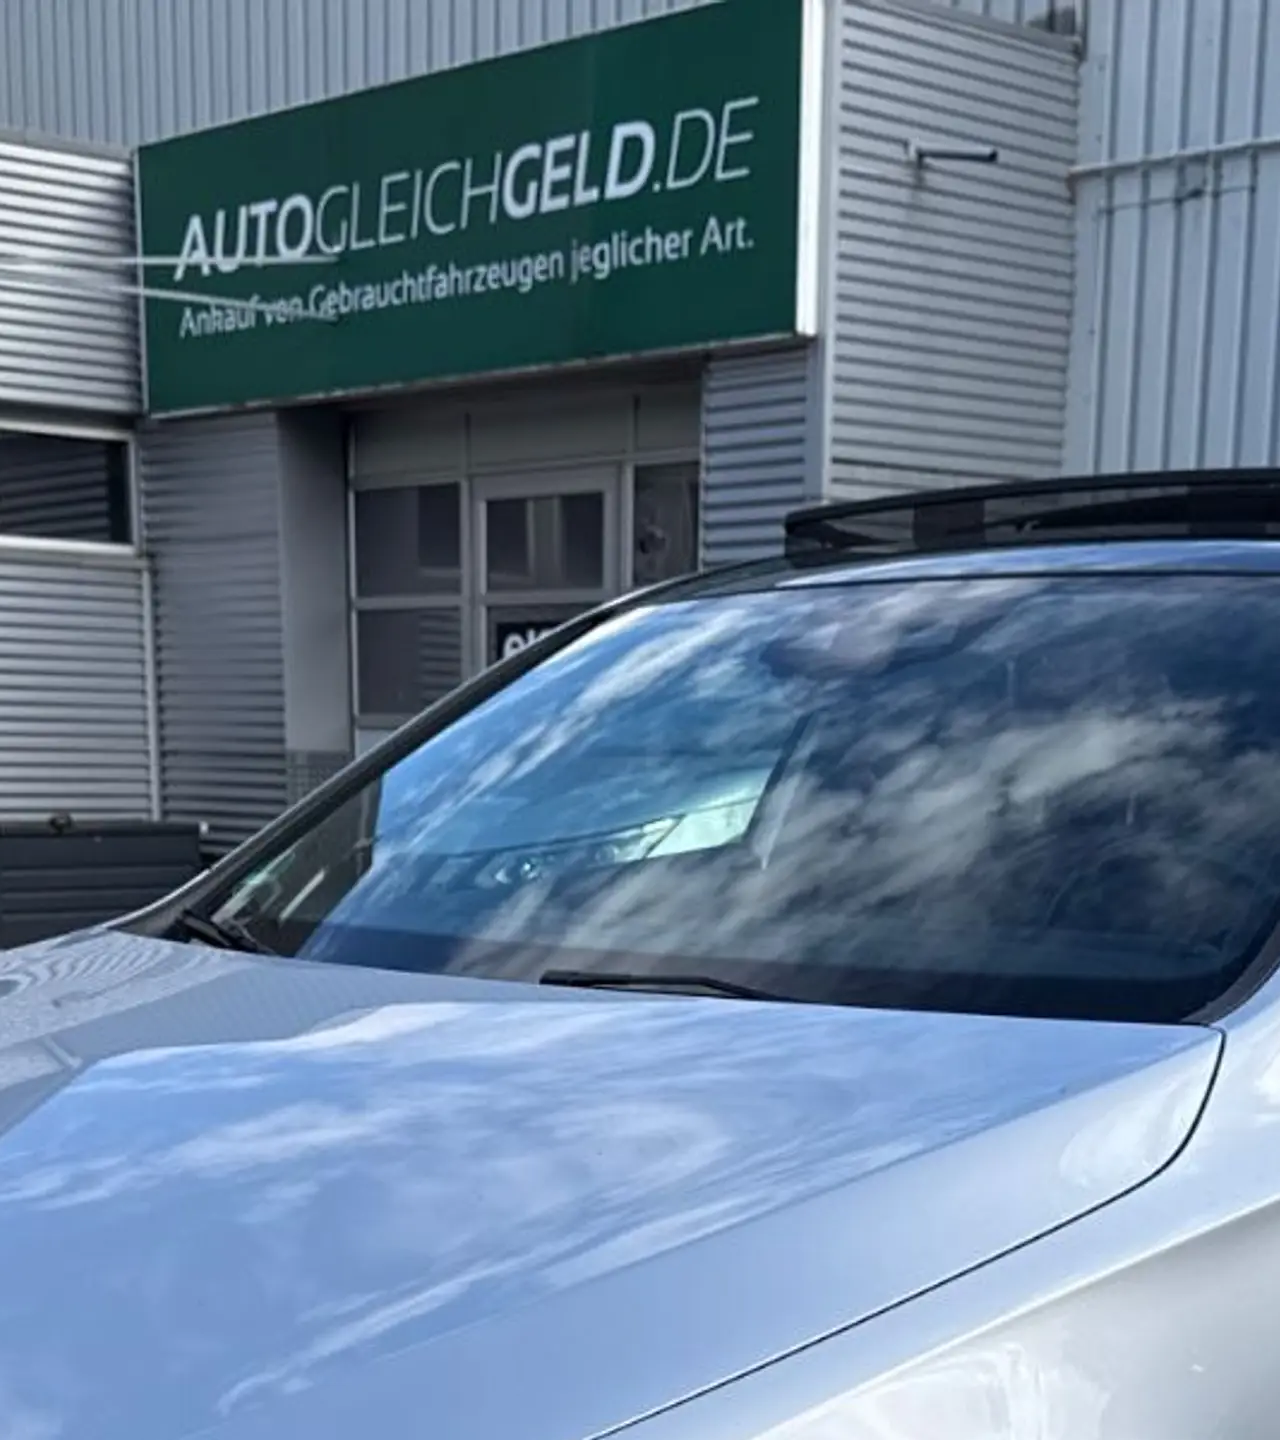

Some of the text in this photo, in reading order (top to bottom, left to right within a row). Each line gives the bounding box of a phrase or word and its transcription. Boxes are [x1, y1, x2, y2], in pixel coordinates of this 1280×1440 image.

[174, 96, 760, 281] AUTOGLEICHGELD.DE
[179, 215, 755, 338] Ankauf von Gebrauchtfahrzeugen jeglicher Art.
